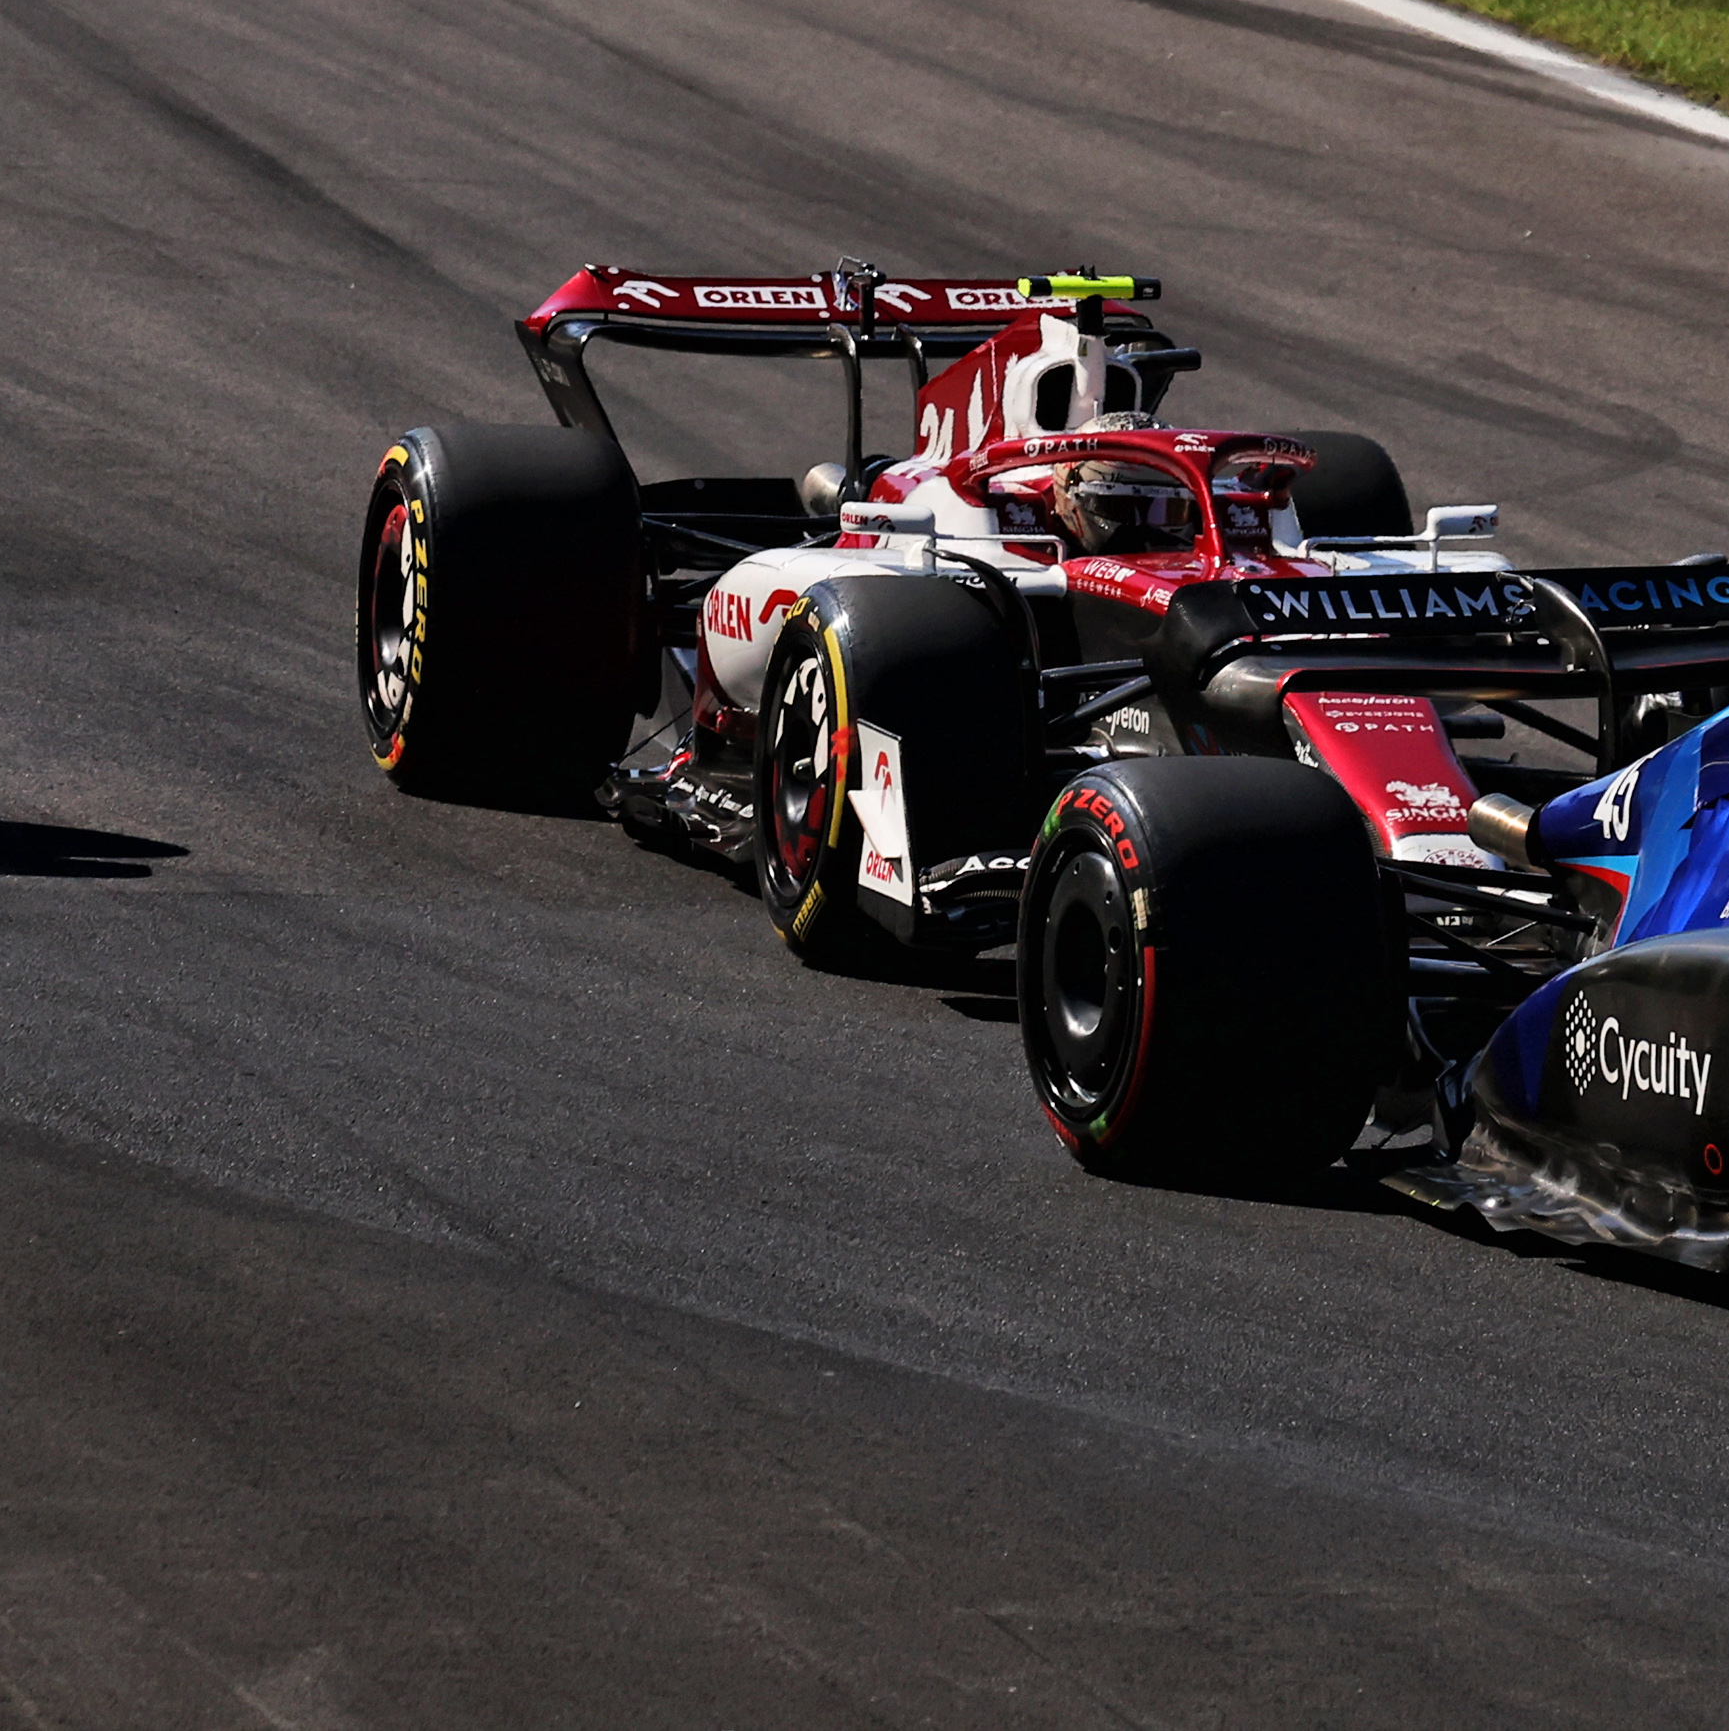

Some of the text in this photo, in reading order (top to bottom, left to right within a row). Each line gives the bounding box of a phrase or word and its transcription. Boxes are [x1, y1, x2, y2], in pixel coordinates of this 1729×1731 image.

[704, 288, 818, 306] ORLEN
[1046, 439, 1098, 452] PATH
[842, 513, 869, 526] ORLEN
[1265, 583, 1533, 620] WILLIAMS
[708, 587, 754, 642] ORLEN
[1364, 723, 1434, 733] PATH
[1385, 807, 1469, 820] SINGH
[1073, 788, 1140, 870] ZERO
[1599, 1017, 1712, 1115] Cycuity
